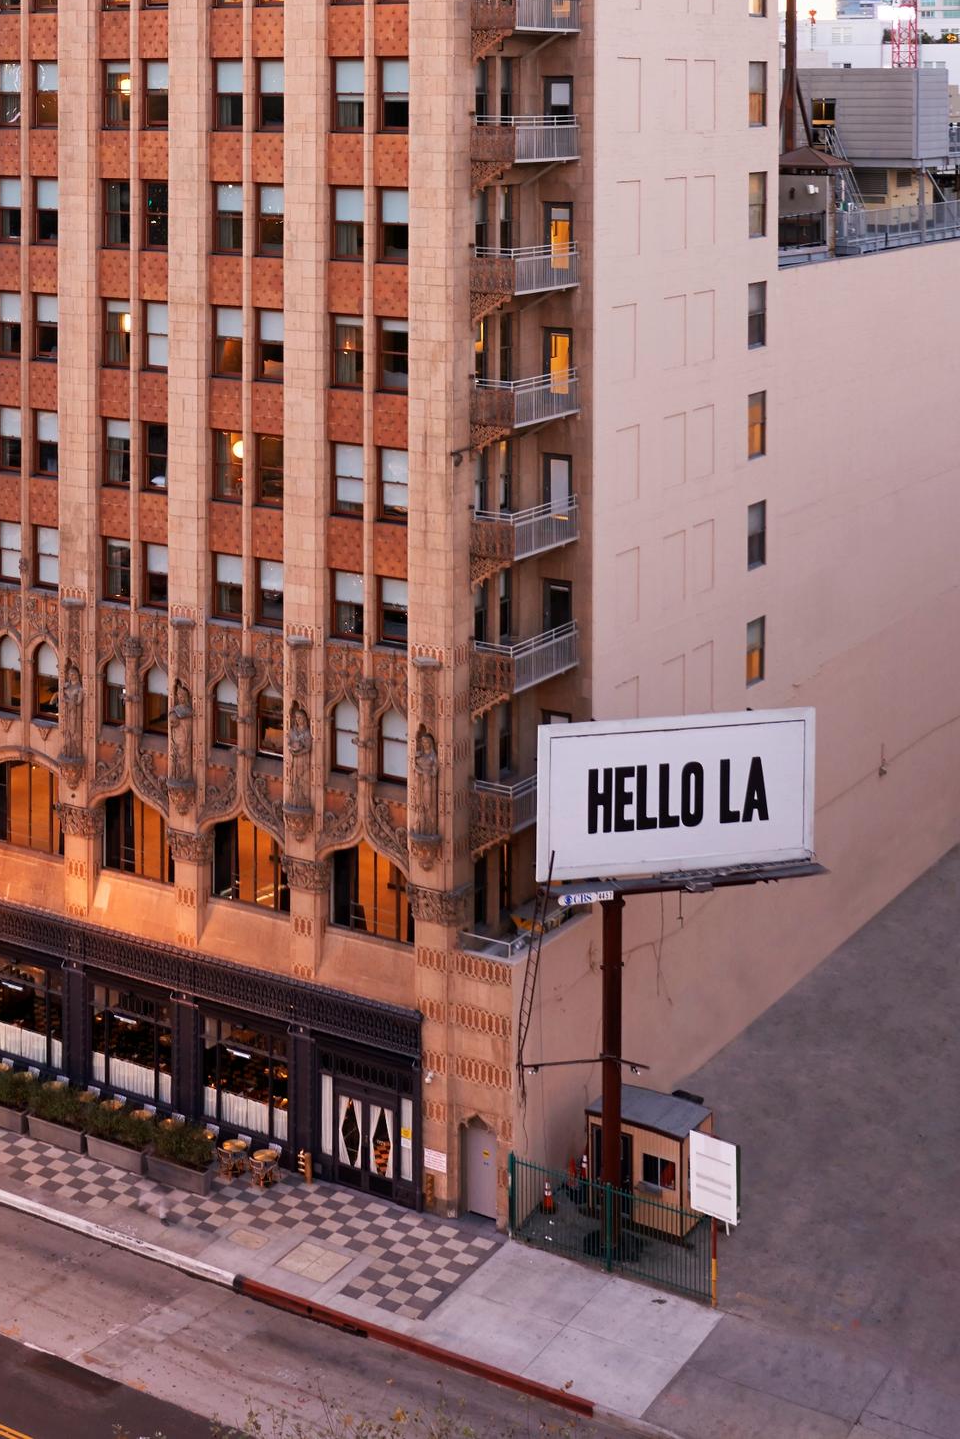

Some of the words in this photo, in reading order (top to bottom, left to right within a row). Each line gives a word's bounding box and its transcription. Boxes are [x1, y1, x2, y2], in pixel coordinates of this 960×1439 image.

[587, 761, 704, 834] HELLO
[719, 756, 770, 824] LA
[574, 892, 592, 904] CBS
